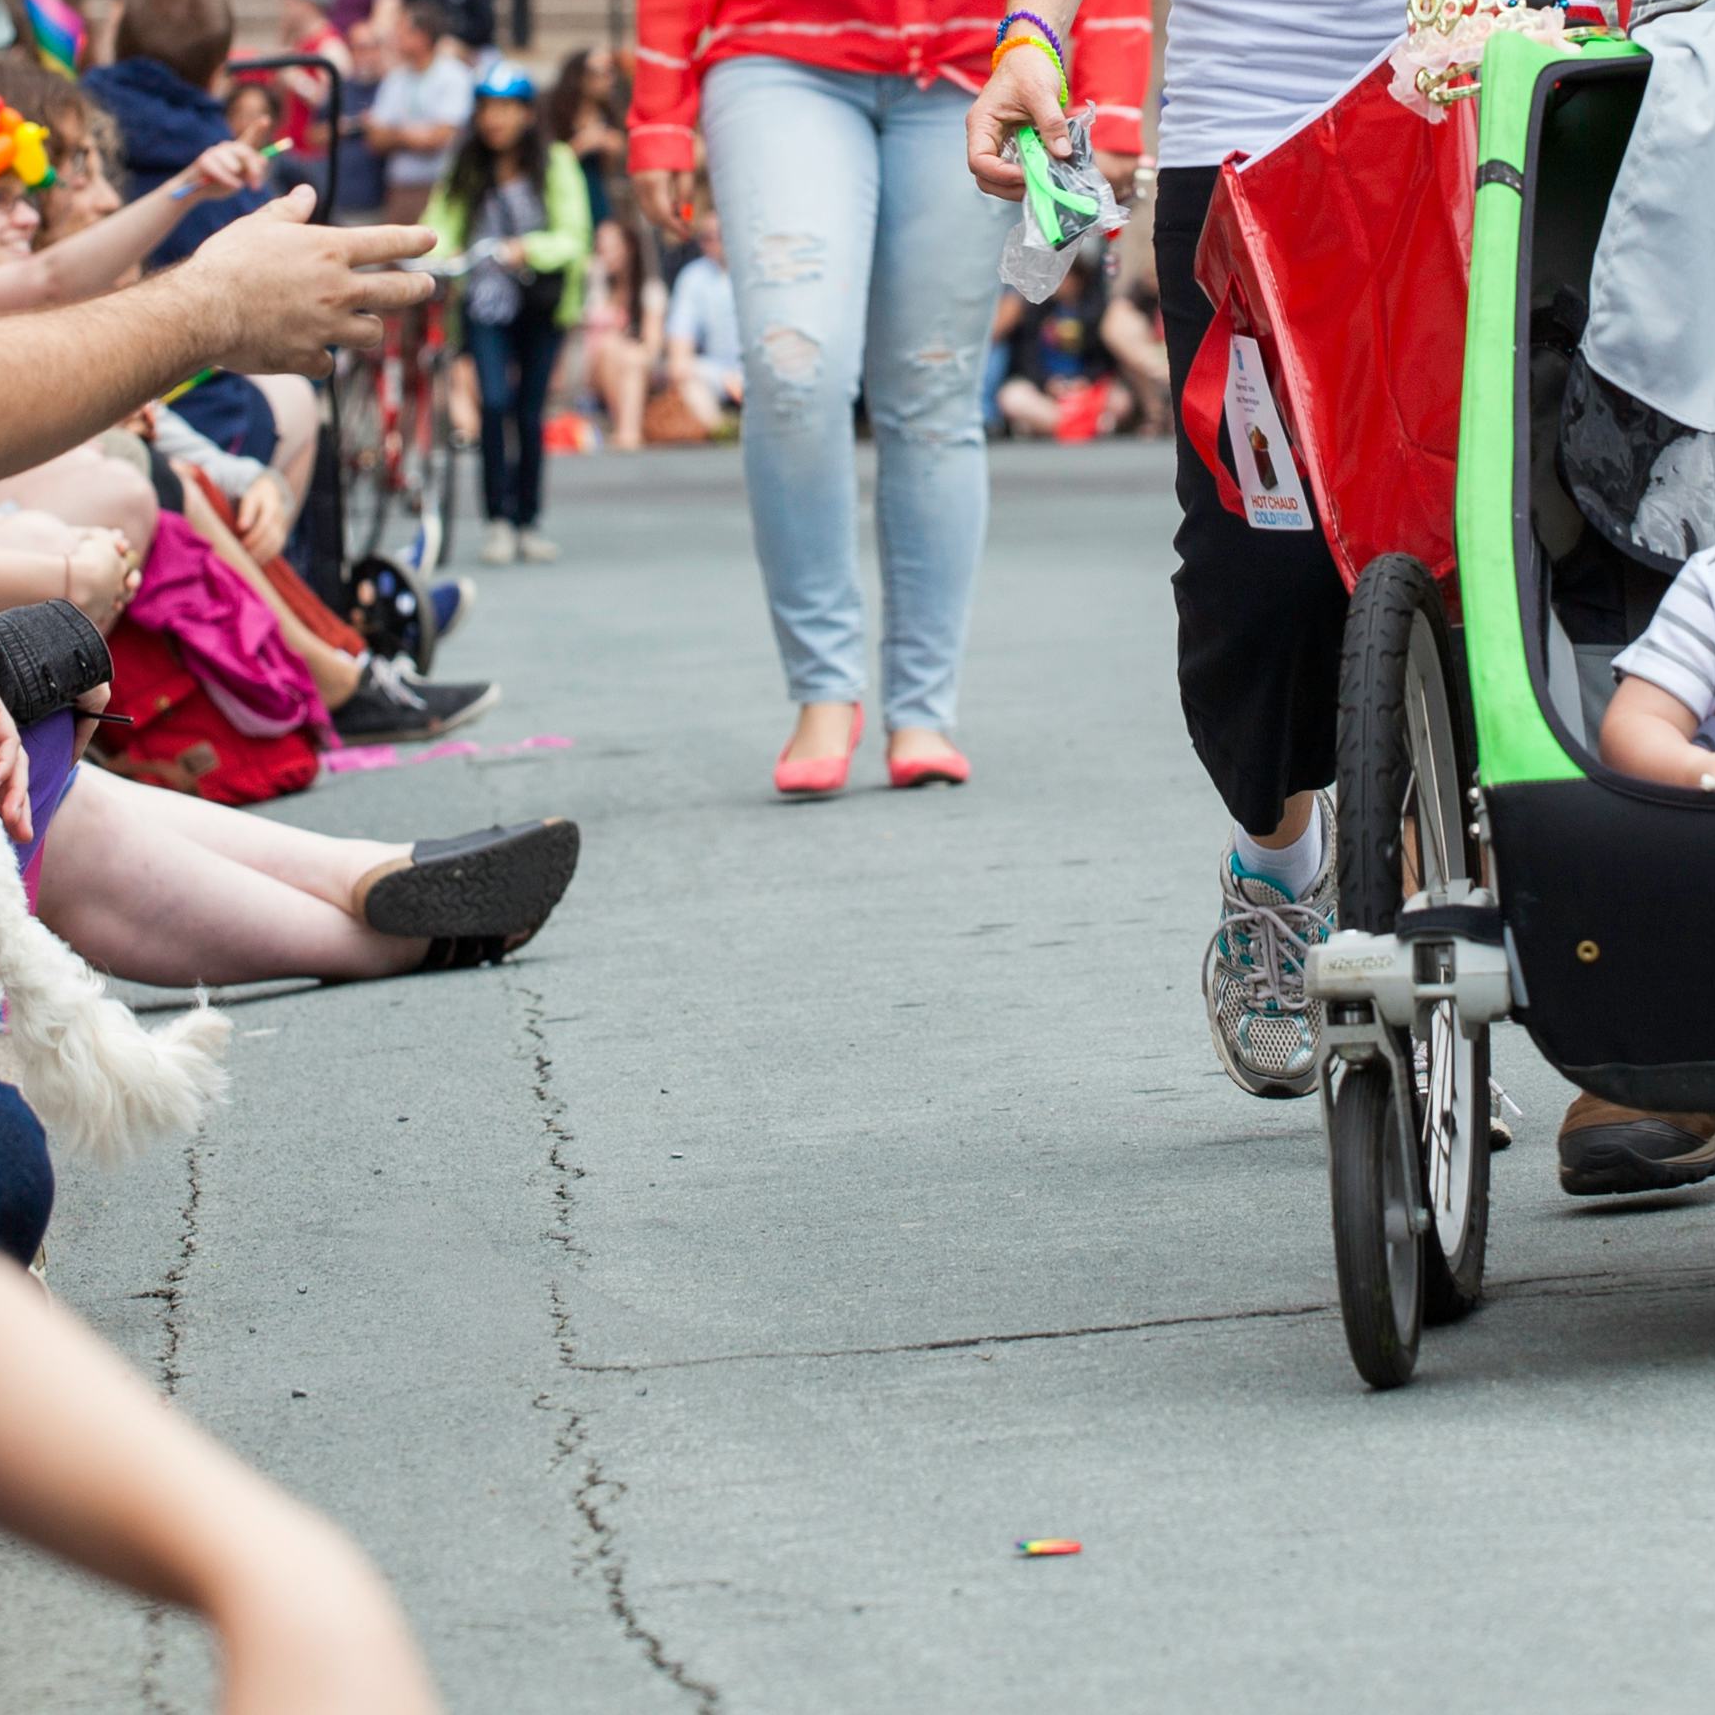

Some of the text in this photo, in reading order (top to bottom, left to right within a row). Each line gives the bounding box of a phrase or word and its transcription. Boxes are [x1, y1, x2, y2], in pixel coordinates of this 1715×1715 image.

[1251, 494, 1299, 511] HOT CHAUD
[1255, 511, 1276, 525] COLD
